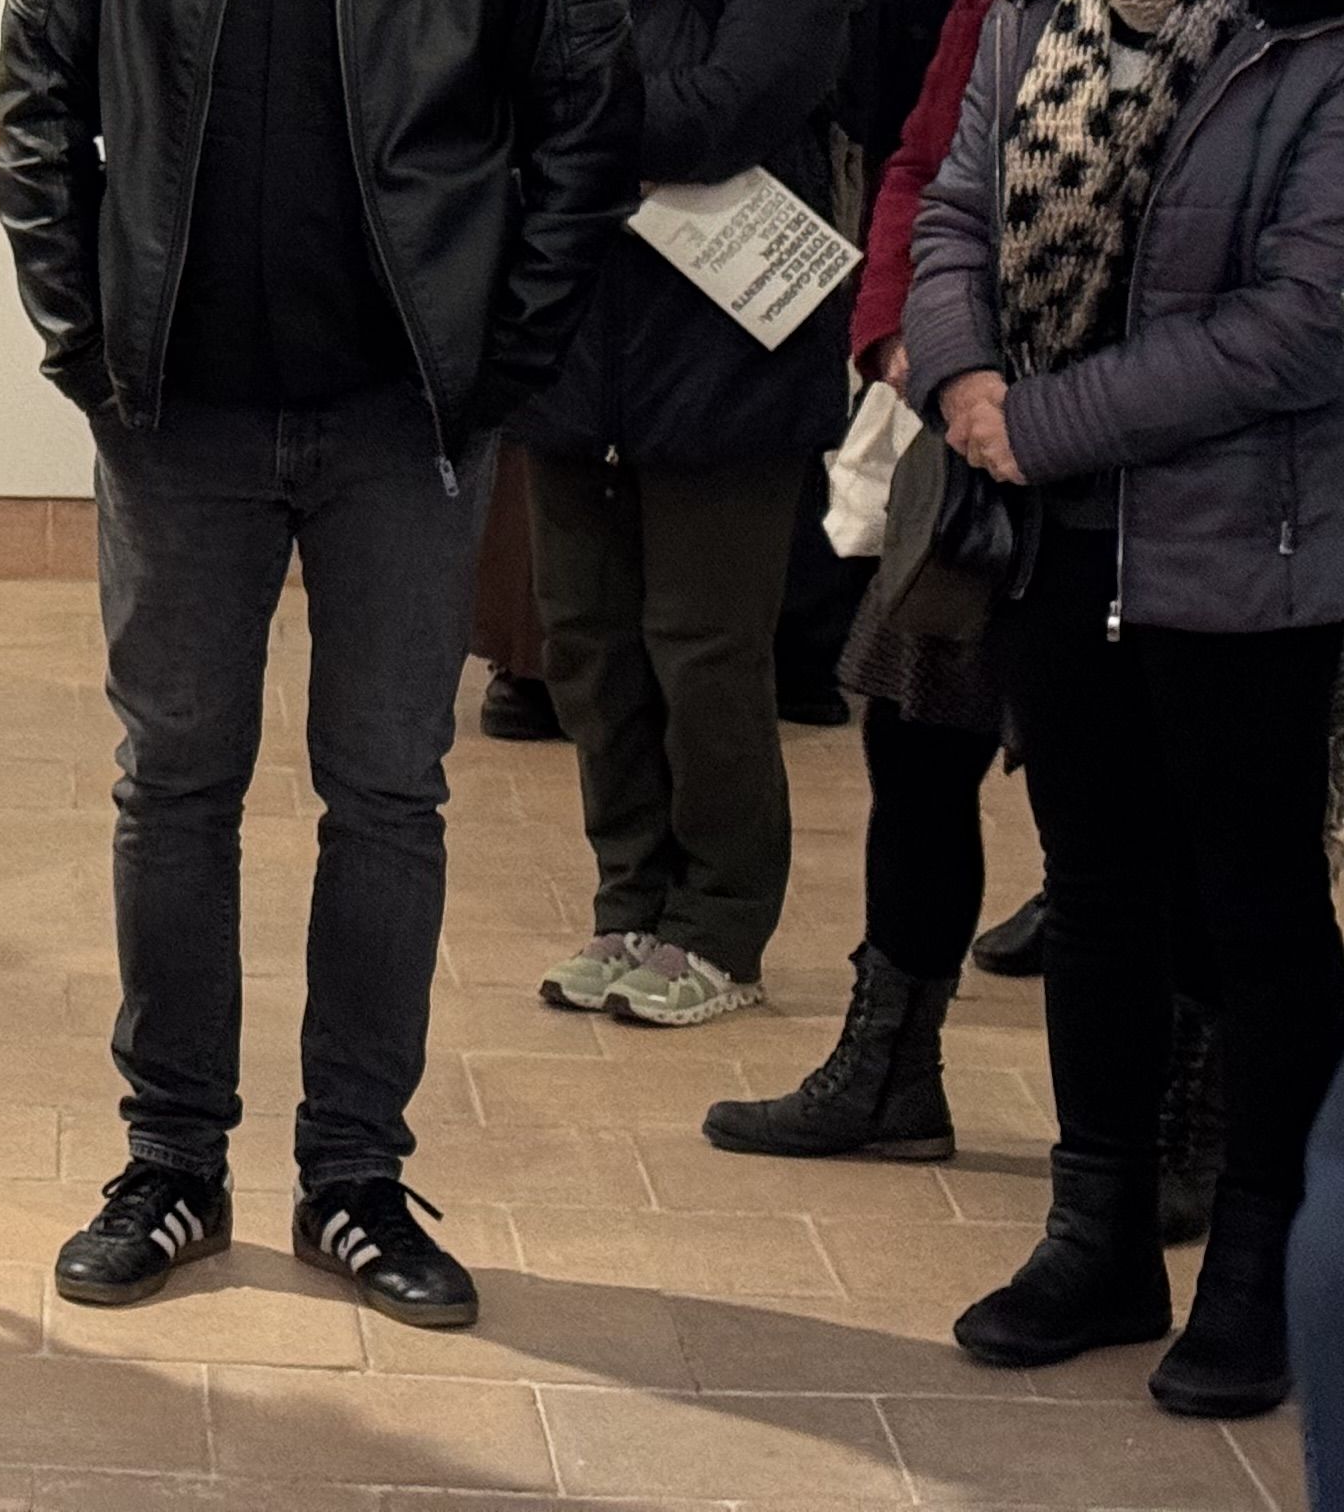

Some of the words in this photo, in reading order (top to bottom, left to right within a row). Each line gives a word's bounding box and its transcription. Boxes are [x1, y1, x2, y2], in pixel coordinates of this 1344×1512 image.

[784, 212, 807, 234] DEL
[799, 231, 829, 261] TOTS
[781, 259, 802, 280] ELS
[815, 250, 850, 287] JOSEP
